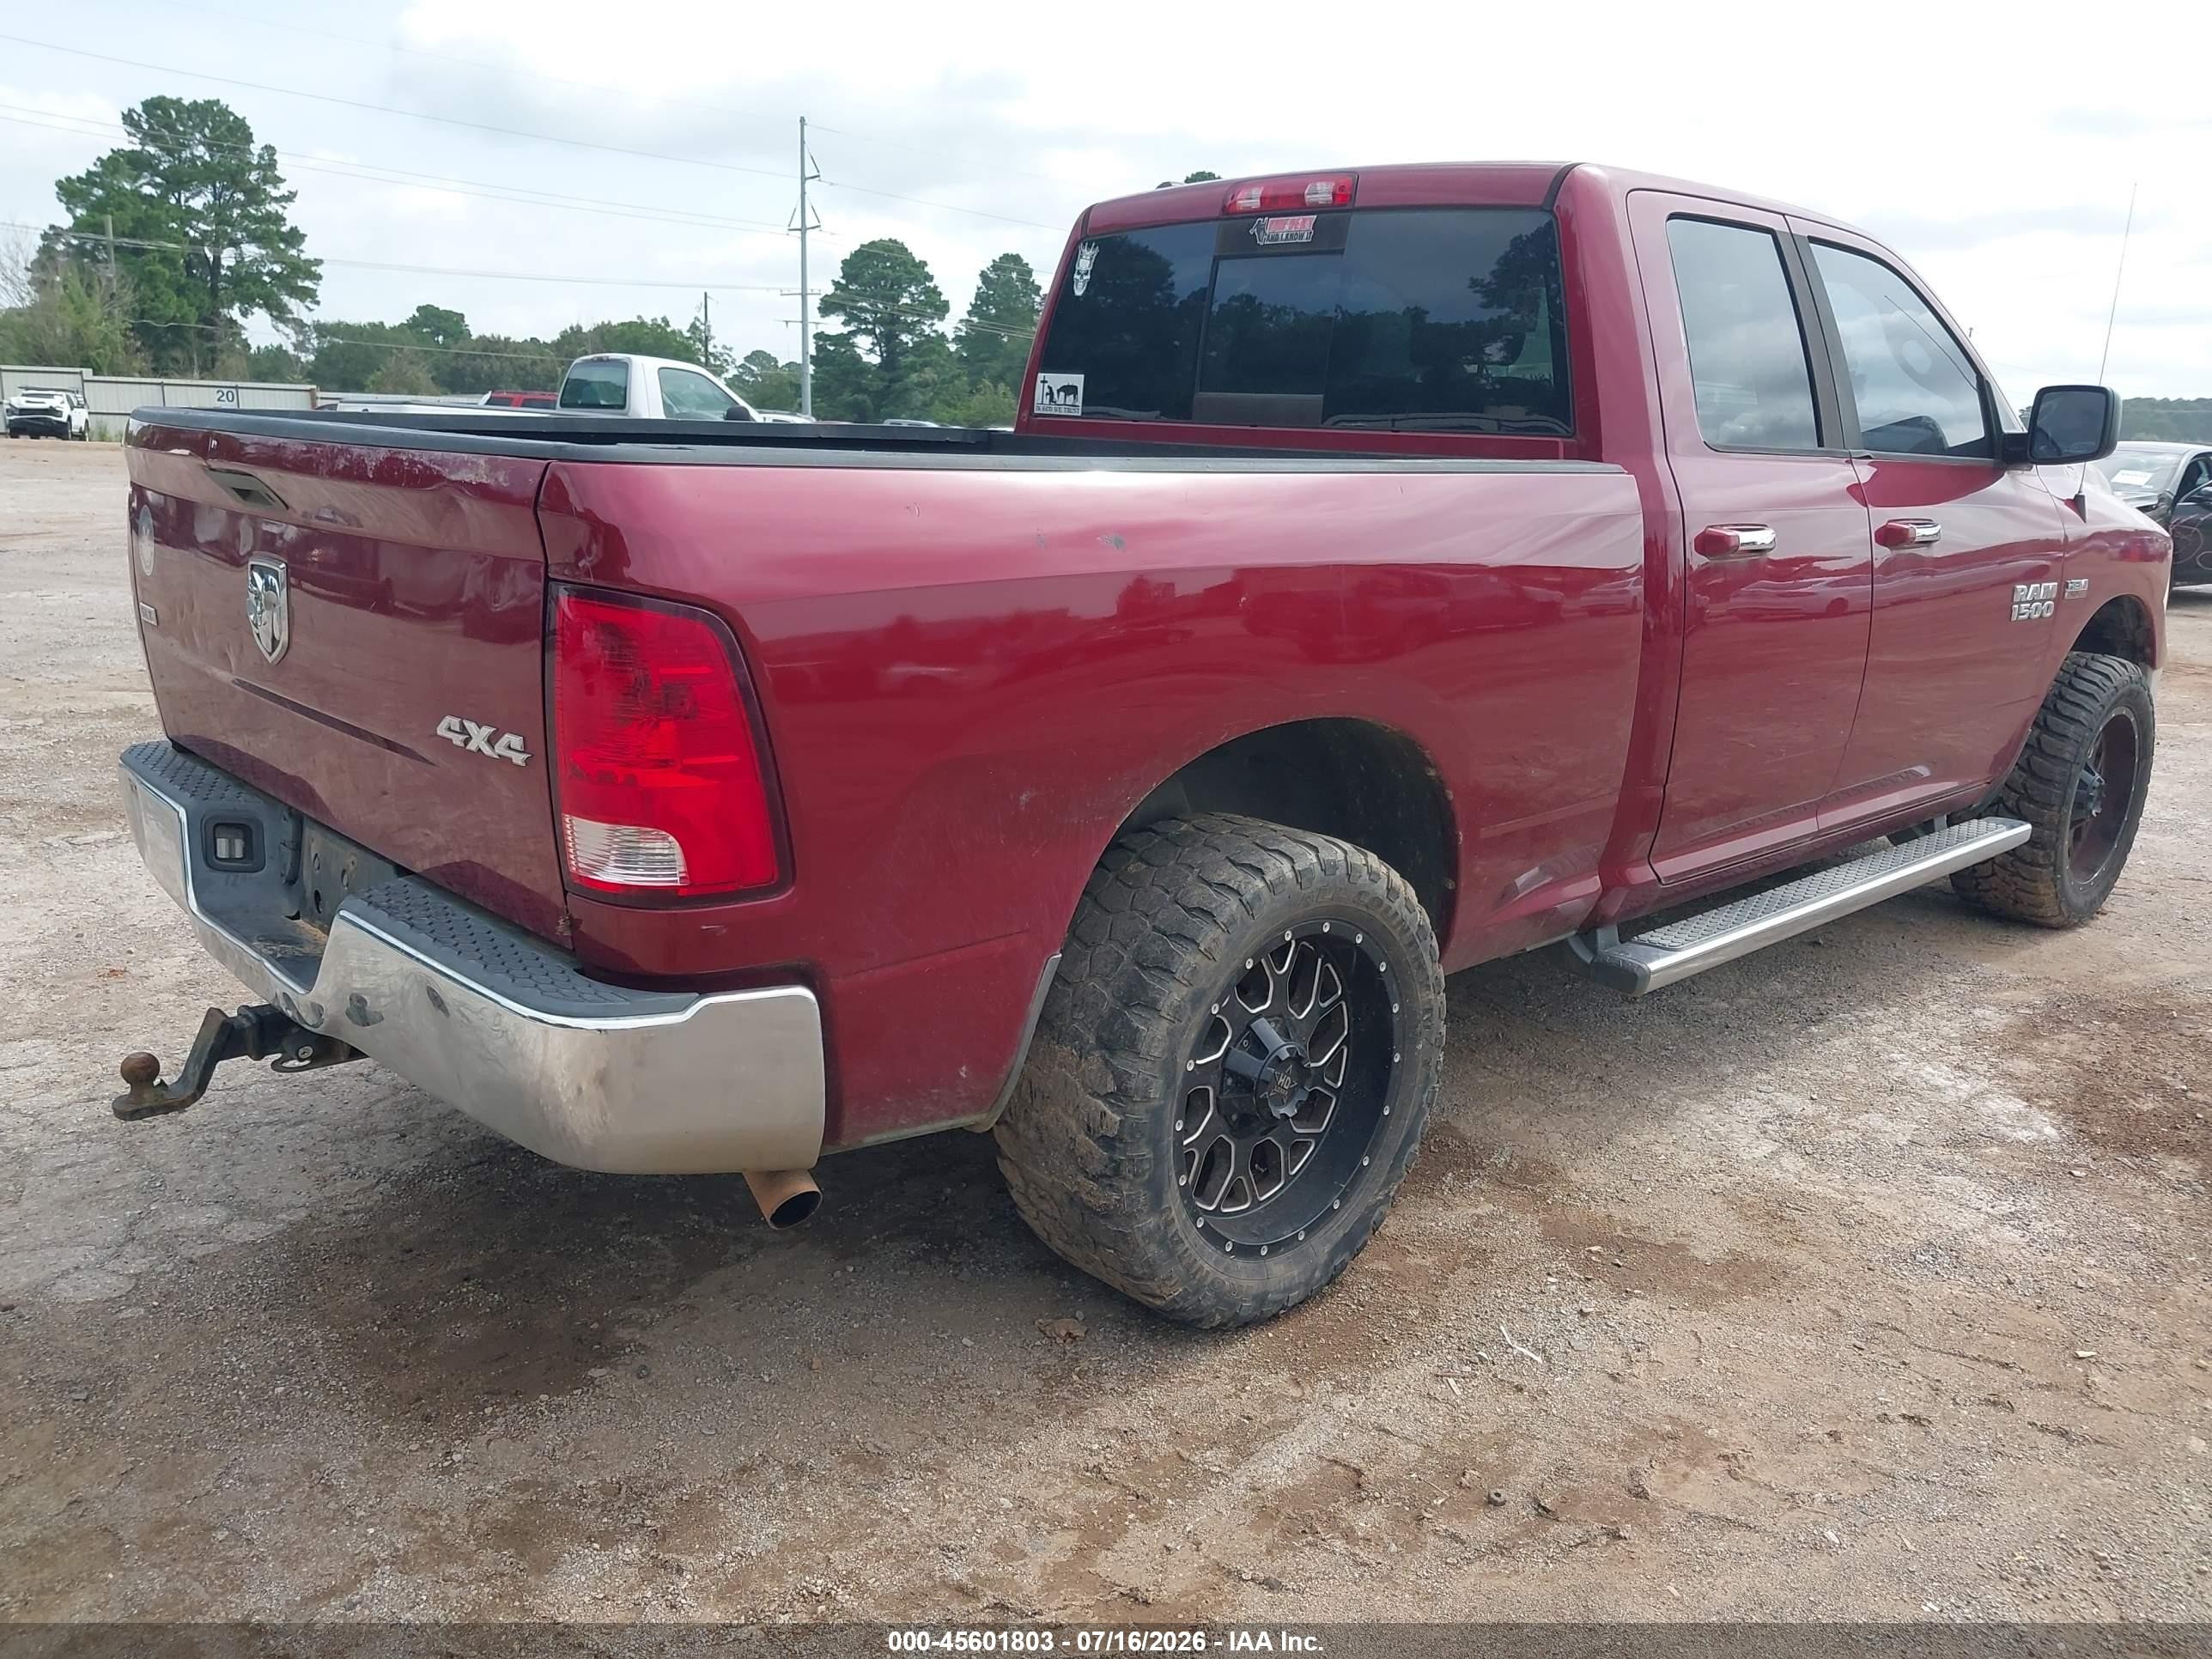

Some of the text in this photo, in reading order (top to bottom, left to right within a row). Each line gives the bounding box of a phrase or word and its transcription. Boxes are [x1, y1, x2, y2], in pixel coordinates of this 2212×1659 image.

[216, 390, 235, 403] 20
[2013, 582, 2058, 602] RAM
[2010, 601, 2055, 622] 1500
[436, 714, 532, 767] 4X4
